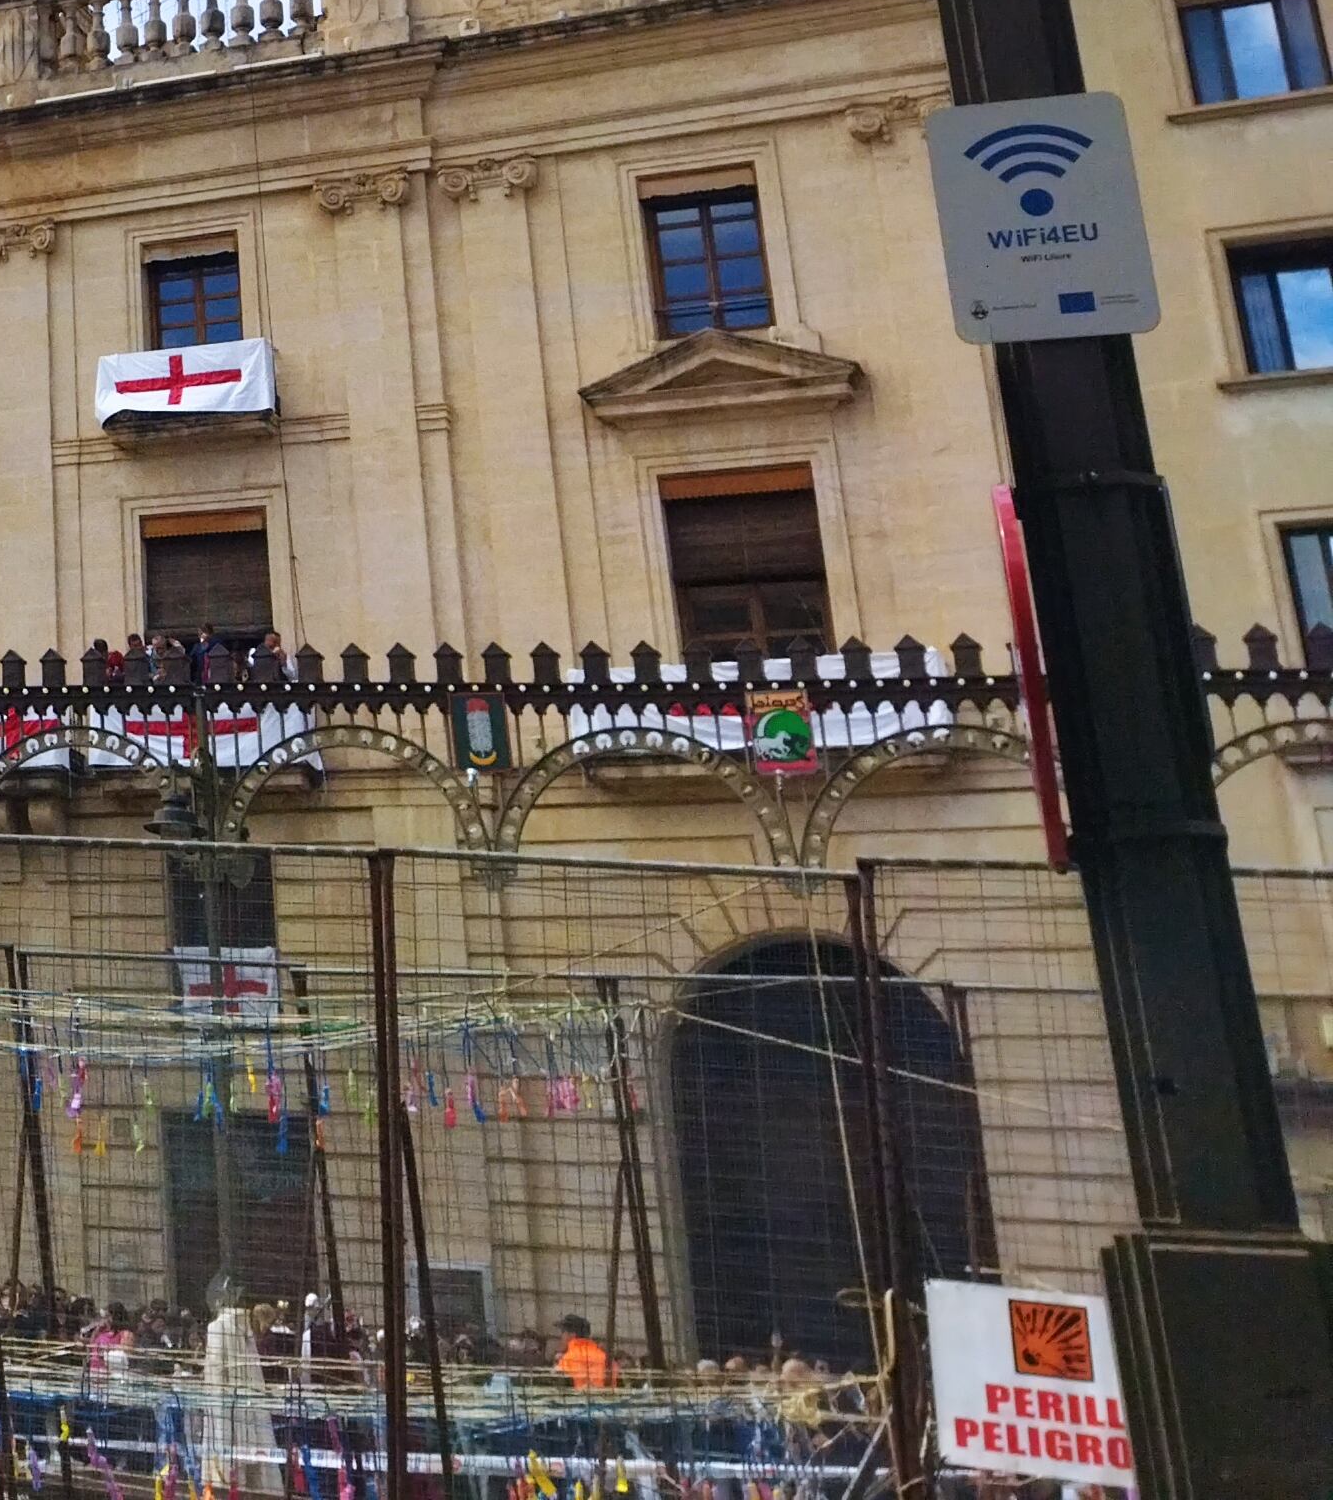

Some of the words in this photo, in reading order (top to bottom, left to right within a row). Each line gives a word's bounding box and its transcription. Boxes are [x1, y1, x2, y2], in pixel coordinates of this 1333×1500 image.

[988, 222, 1099, 249] WiFi4EU
[985, 1383, 1125, 1430] PERILL
[954, 1417, 1132, 1470] PELIGRO
